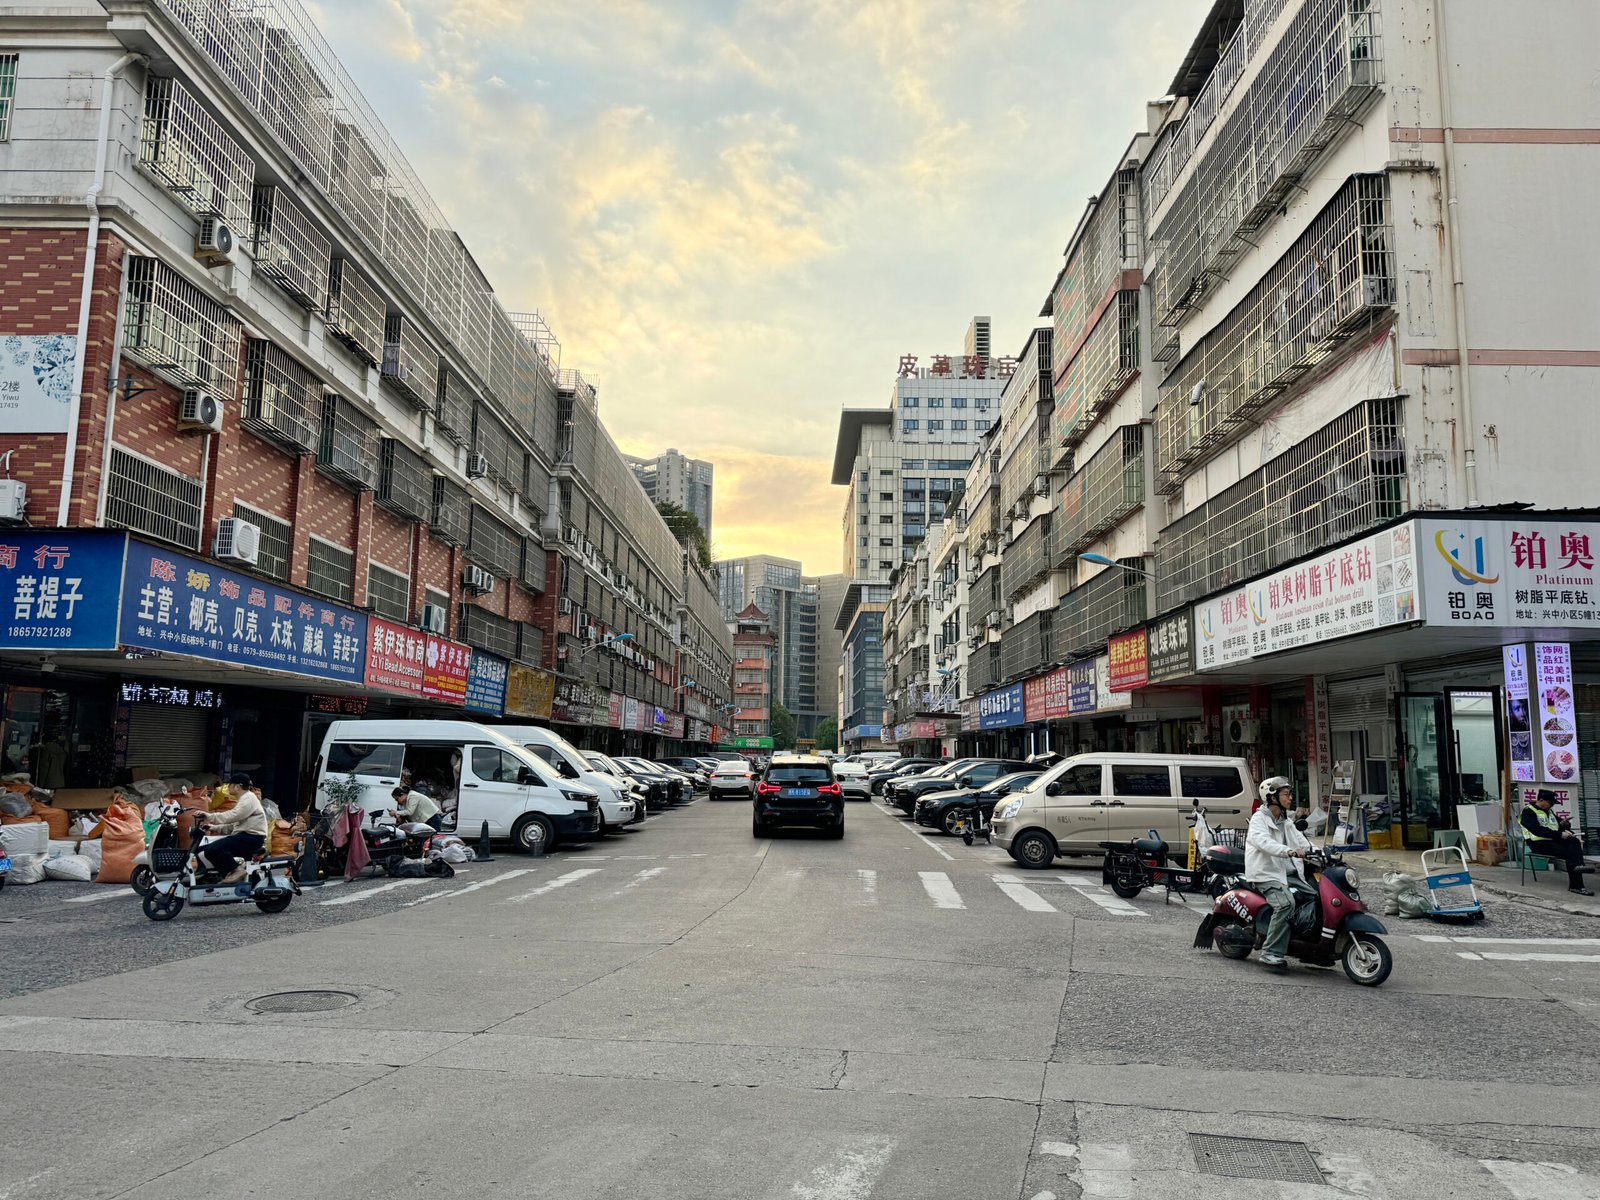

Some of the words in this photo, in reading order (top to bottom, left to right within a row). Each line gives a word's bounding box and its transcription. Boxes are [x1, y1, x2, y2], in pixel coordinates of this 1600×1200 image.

[897, 353, 1019, 377] 皮革珠宝
[1510, 531, 1595, 571] 铂奥
[1268, 545, 1371, 610] 铂奥树脂平底钻
[1536, 574, 1594, 585] Platinum
[14, 575, 83, 620] 菩提子
[1448, 591, 1494, 609] 铂奥
[1451, 611, 1494, 620] BOAO
[8, 627, 72, 638] 18657921288
[371, 655, 378, 668] Zi
[378, 656, 384, 670] Yi
[385, 659, 398, 673] Bead
[1542, 645, 1555, 684] 饰品配件
[1553, 645, 1565, 684] 网红美甲
